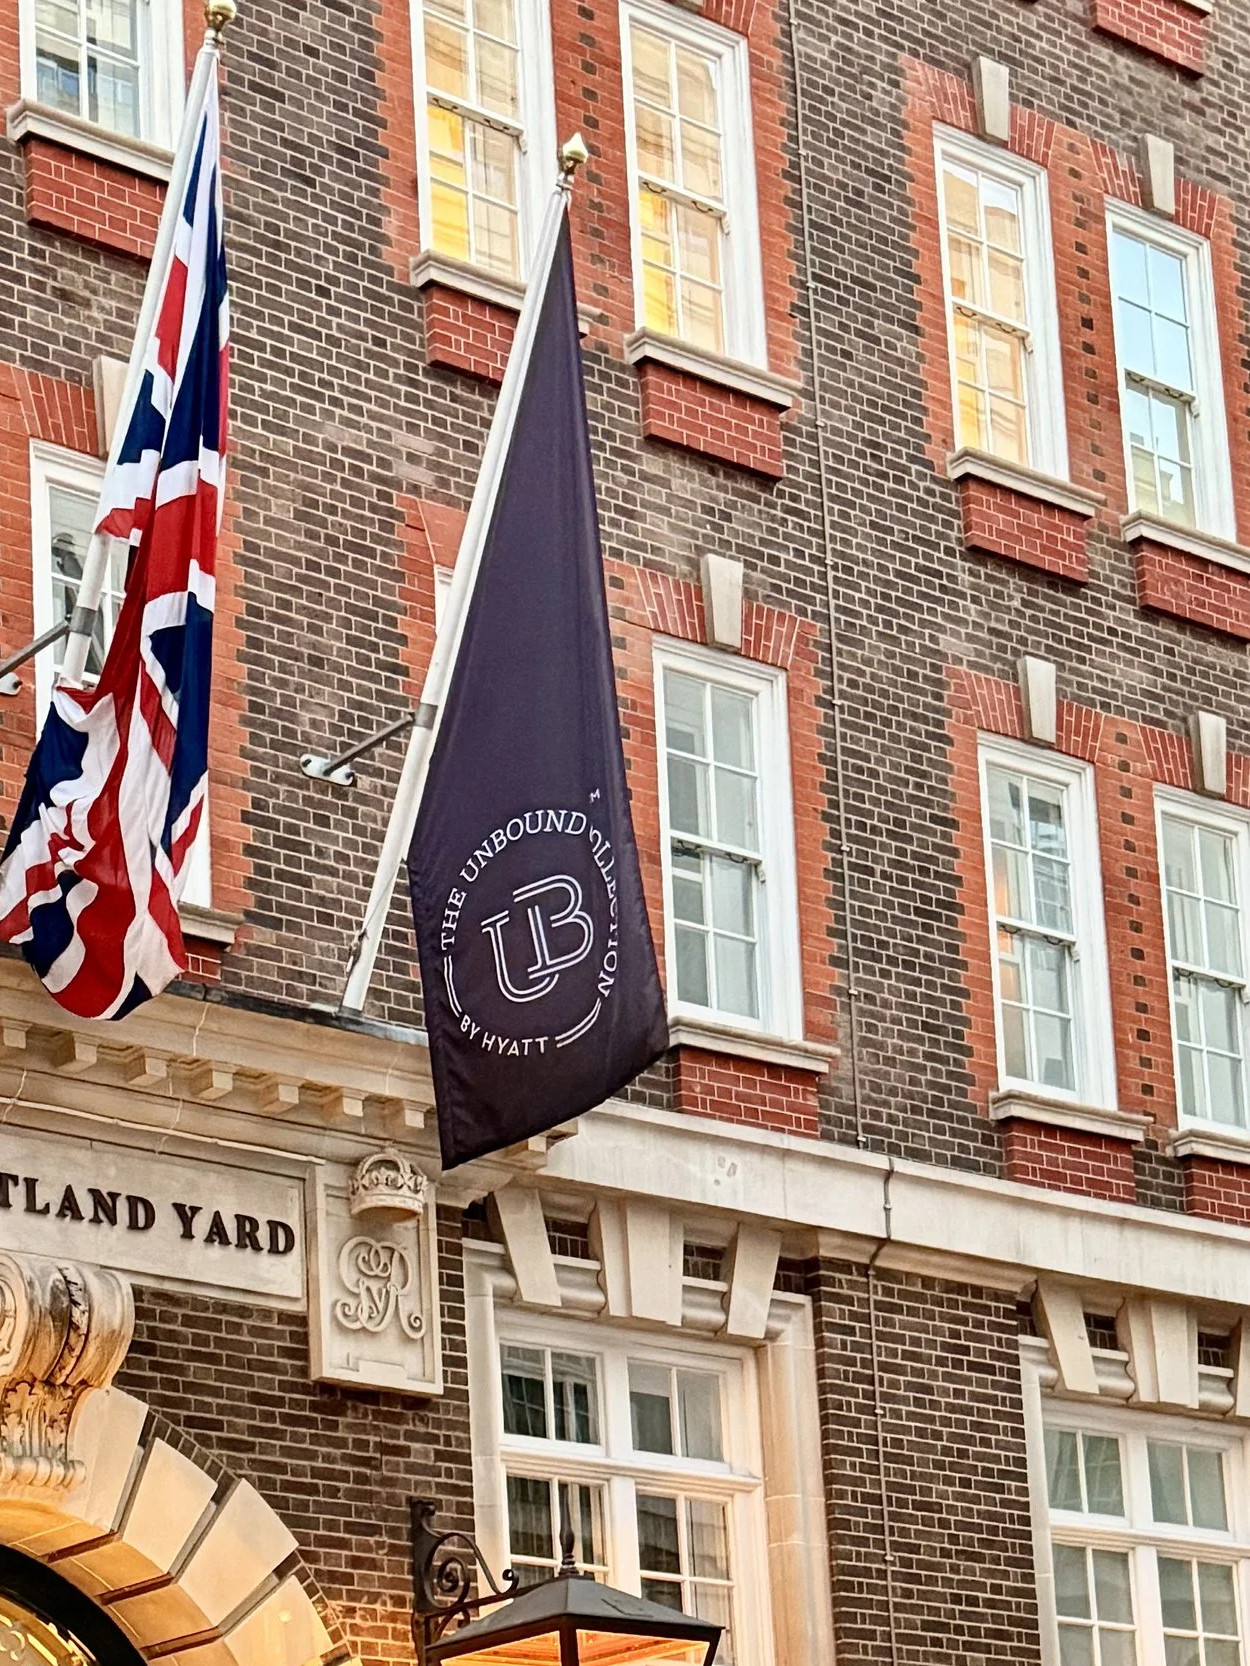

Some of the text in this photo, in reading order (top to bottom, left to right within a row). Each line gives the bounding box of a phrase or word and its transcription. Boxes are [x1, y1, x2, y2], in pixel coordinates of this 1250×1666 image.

[441, 888, 467, 951] THE
[459, 809, 587, 882] UNBOUND
[460, 1014, 549, 1056] BY HYATT
[171, 1202, 296, 1256] YARD
